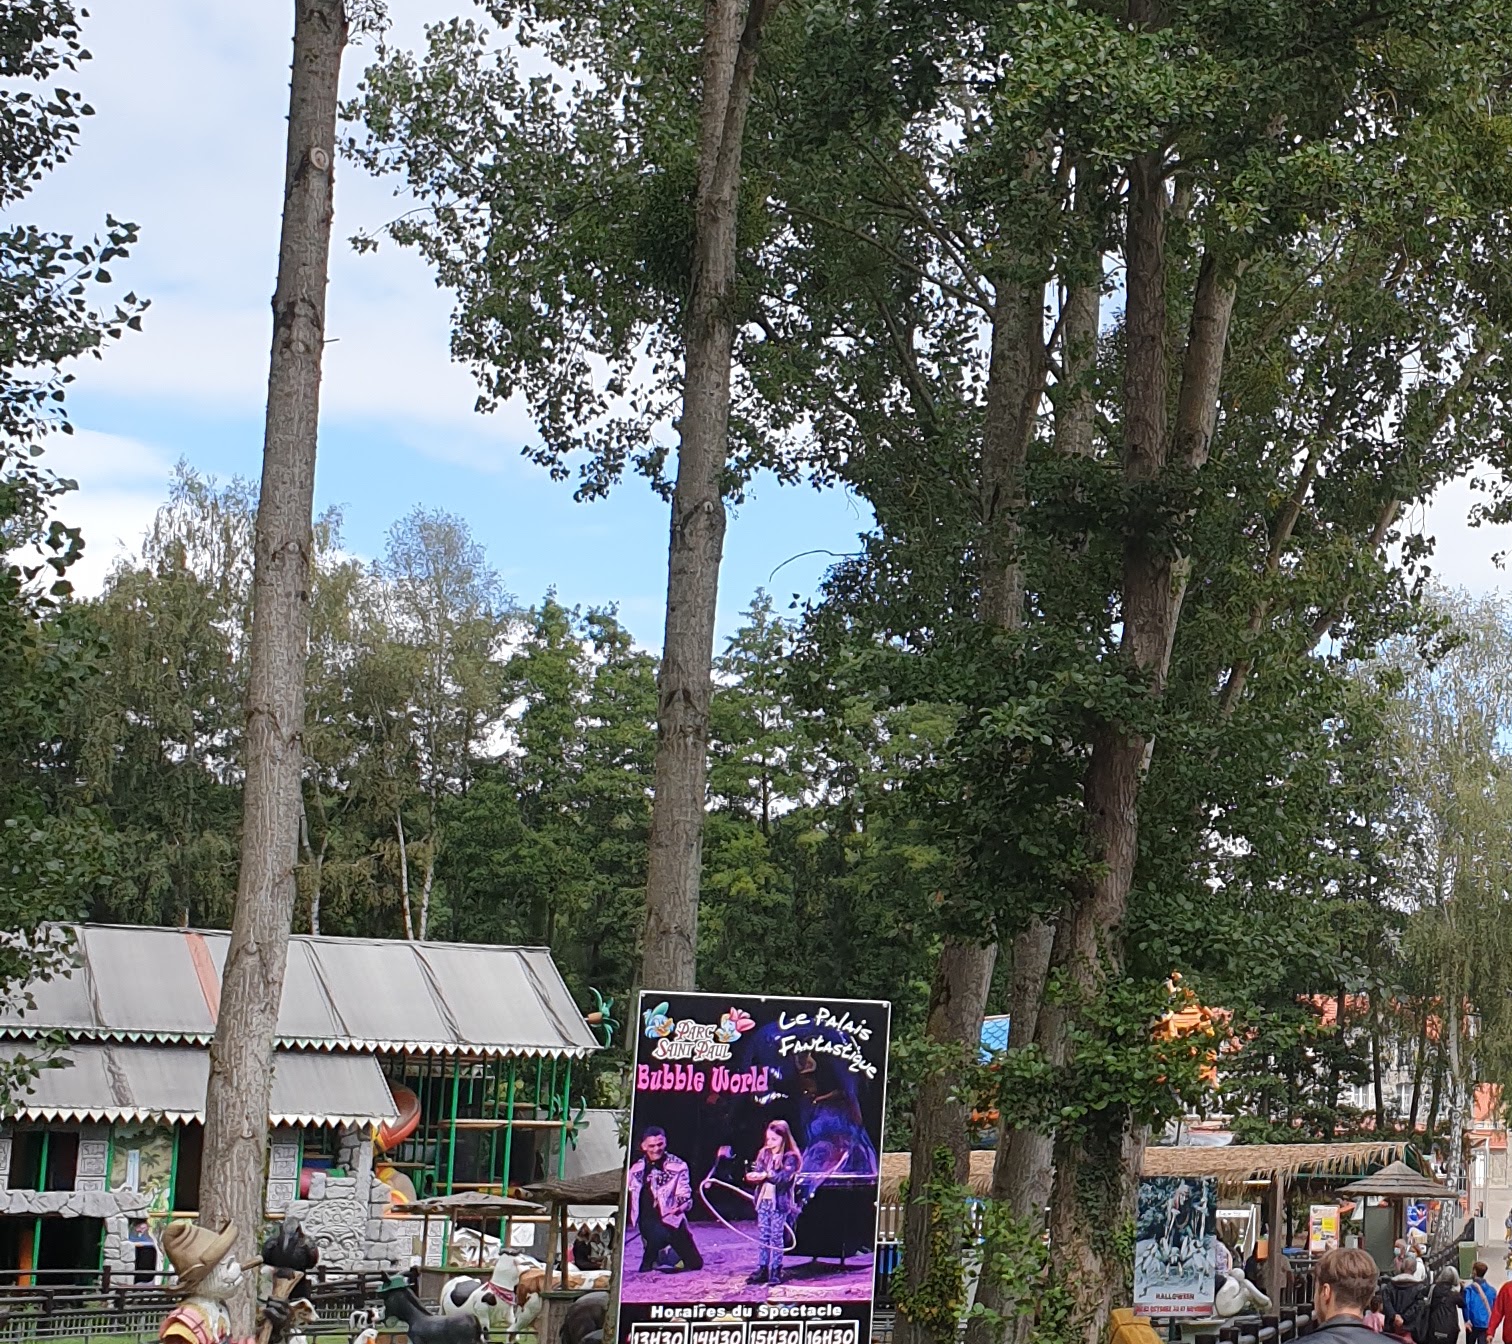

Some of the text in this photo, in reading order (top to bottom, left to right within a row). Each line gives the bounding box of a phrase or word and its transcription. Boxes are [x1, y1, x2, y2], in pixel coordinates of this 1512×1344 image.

[674, 1019, 717, 1042] PARC
[779, 1012, 810, 1030] Le
[652, 1037, 732, 1061] SAINT PAUL
[637, 1063, 769, 1093] Bubble World
[651, 1303, 842, 1320] Horaires du Spectacle
